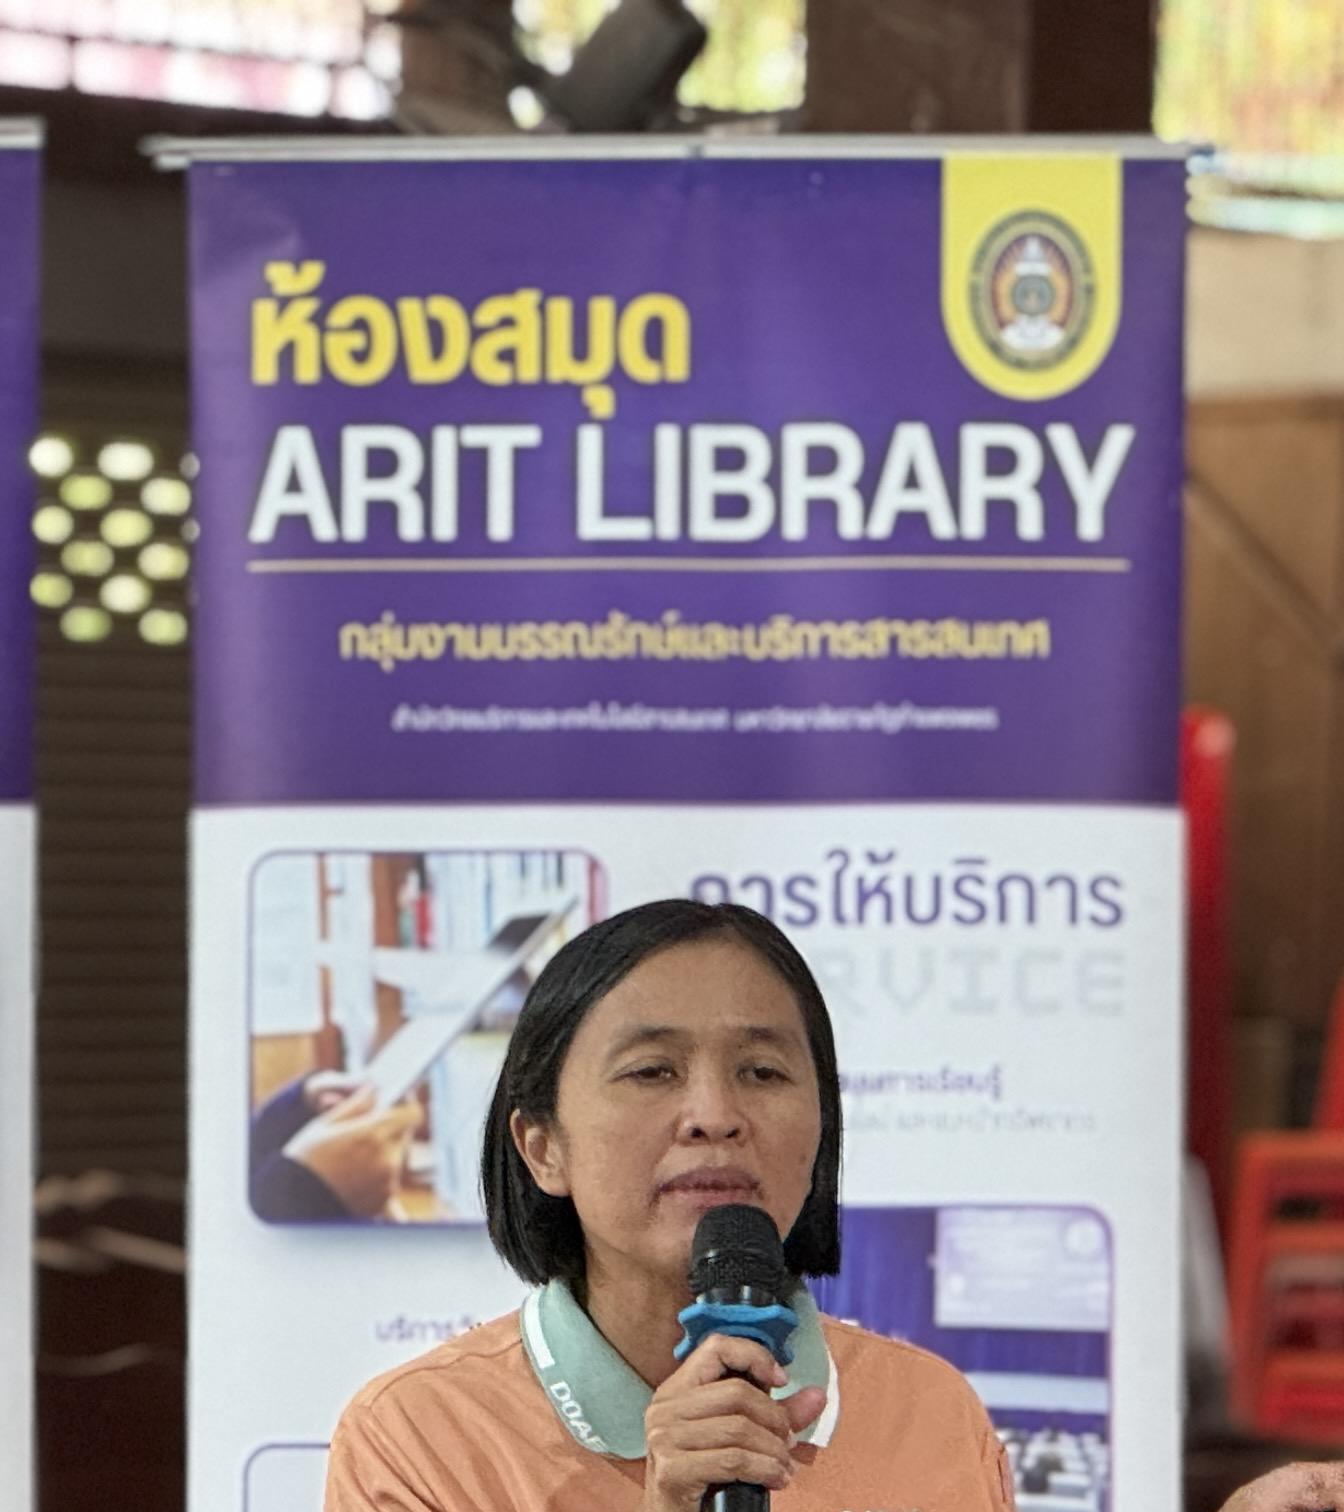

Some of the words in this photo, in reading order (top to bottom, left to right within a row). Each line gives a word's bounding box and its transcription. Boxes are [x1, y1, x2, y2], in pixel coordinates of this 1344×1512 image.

[251, 261, 692, 420] ห้องสมุด
[249, 423, 547, 543] ARIT
[575, 422, 1136, 543] LIBRARY
[811, 946, 1126, 1018] RVICE
